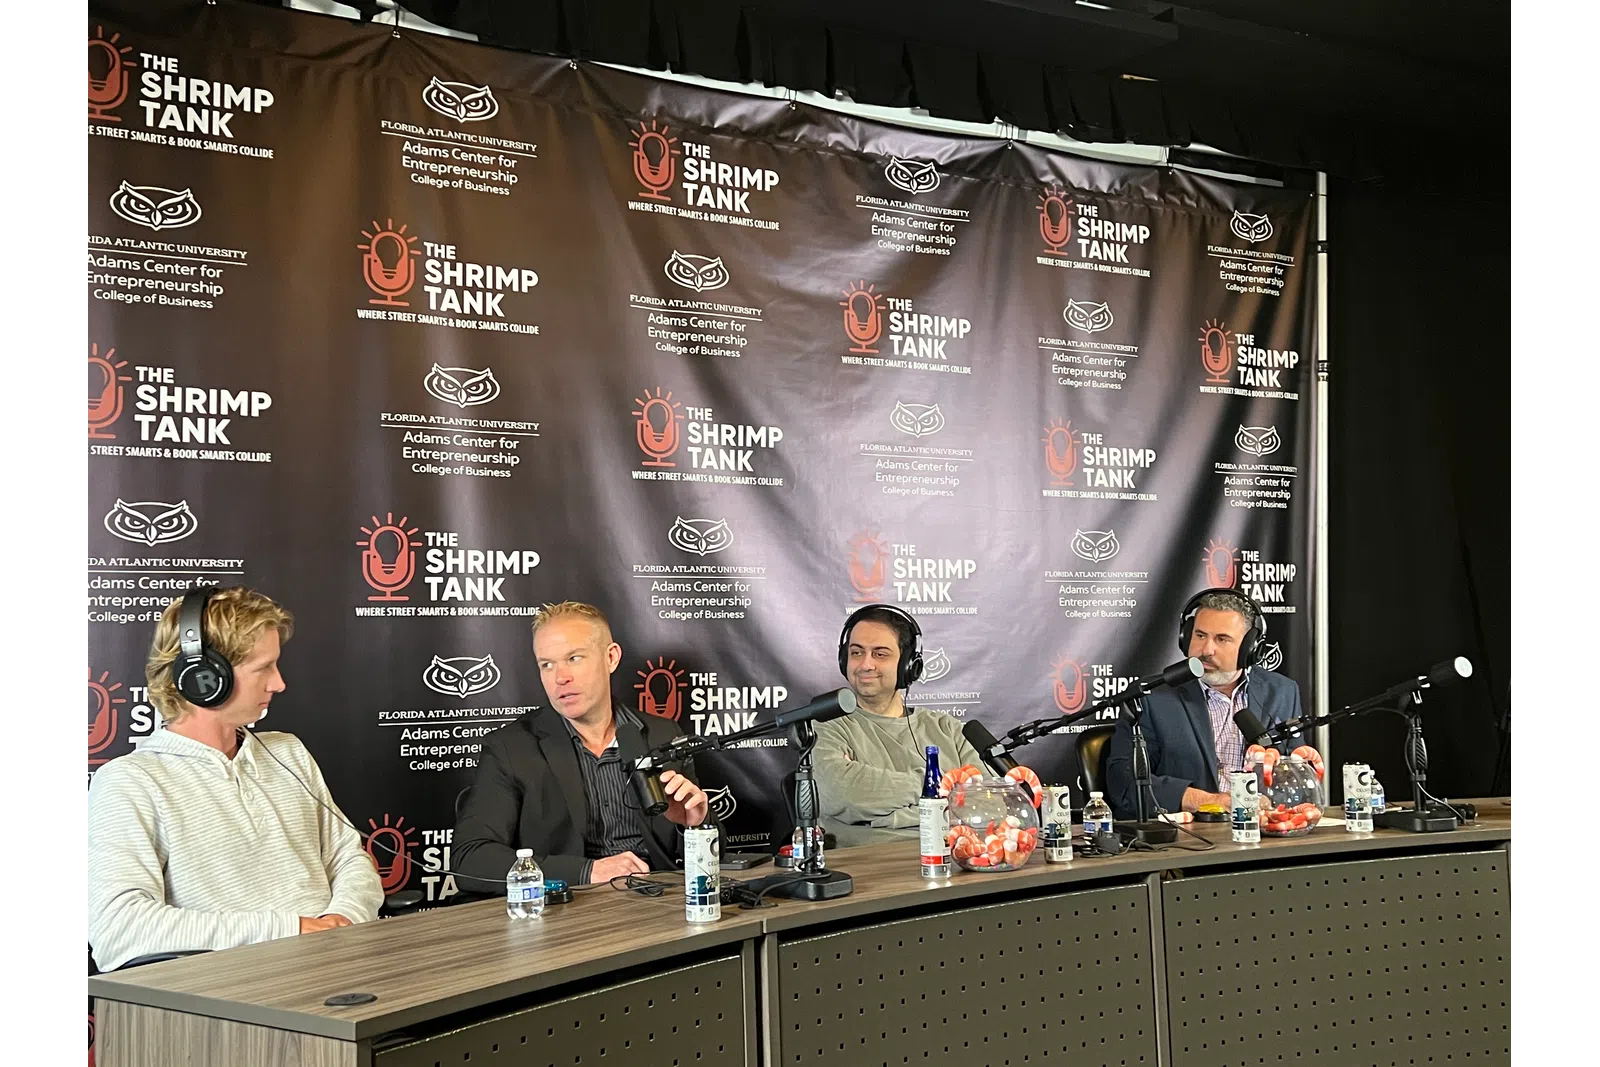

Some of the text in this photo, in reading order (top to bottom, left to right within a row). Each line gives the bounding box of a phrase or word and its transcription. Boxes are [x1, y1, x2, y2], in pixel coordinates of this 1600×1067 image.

[139, 53, 179, 73] THE
[140, 70, 276, 116] SHRIMP
[139, 100, 234, 139] TANK
[96, 126, 130, 140] STREET
[131, 130, 168, 145] SMARTS
[169, 136, 176, 147] &
[178, 137, 202, 150] BOOK
[203, 140, 238, 155] SMARTS
[239, 145, 275, 160] COLLIDE
[380, 121, 537, 152] FLORIDA ATLANTIC UNIVERSITY
[402, 140, 518, 168] Adams Center for
[682, 142, 710, 159] THE
[401, 156, 518, 186] Entrepreneurship
[683, 157, 780, 193] SHRIMP
[410, 173, 510, 196] College of Business
[683, 182, 750, 214] TANK
[629, 201, 780, 232] WHERE STREET SMARTS & BOOK SMARTS COLLIDE
[1077, 204, 1098, 217] THE
[871, 212, 954, 233] Adams Center for
[1077, 217, 1151, 245] SHRIMP
[88, 232, 248, 259] RIDA ATLANTIC UNIVERSITY
[871, 225, 955, 248] Entrepreneurship
[423, 242, 456, 259] THE
[1077, 238, 1129, 263] TANK
[88, 253, 224, 278] Adams Center for
[88, 270, 224, 297] Entrepreneurship
[423, 259, 540, 294] SHRIMP
[93, 289, 214, 309] College of Business
[423, 286, 504, 317] TANK
[888, 297, 912, 311] THE
[357, 308, 540, 336] WHERE STREET SMARTS & BOOK SMARTS COLLIDE
[646, 312, 747, 332] Adams Center for
[888, 311, 972, 340] SHRIMP
[646, 327, 748, 348] Entrepreneurship
[889, 334, 947, 360] TANK
[1236, 334, 1254, 345] THE
[654, 342, 741, 358] College of Business
[1052, 352, 1126, 367] Adams Center for
[1236, 346, 1299, 369] SHRIMP
[135, 366, 175, 384] THE
[1052, 364, 1127, 381] Entrepreneurship
[1235, 366, 1279, 388] TANK
[1058, 377, 1121, 390] College of Business
[135, 384, 274, 418] SHRIMP
[381, 413, 539, 431] FLORIDA ATLANTIC UNIVERSITY
[685, 406, 713, 421] THE
[134, 414, 231, 445] TANK
[686, 422, 784, 449] SHRIMP
[1081, 433, 1103, 445] THE
[403, 431, 519, 449] Adams Center for
[403, 447, 519, 467] Entrepreneurship
[686, 447, 754, 472] TANK
[875, 459, 909, 470] Adams
[911, 461, 942, 472] Center
[1082, 446, 1158, 468] SHRIMP
[412, 463, 511, 477] College of Business
[1083, 468, 1135, 489] TANK
[1223, 476, 1292, 486] Adams Center for
[1224, 488, 1293, 499] Entrepreneurship
[425, 532, 458, 547] THE
[891, 544, 916, 556] THE
[1241, 551, 1260, 561] THE
[425, 549, 541, 574] SHRIMP
[892, 558, 978, 579] SHRIMP
[1242, 563, 1296, 581] SHRIMP
[425, 577, 505, 601] TANK
[651, 581, 751, 592] Adams Center for
[892, 581, 953, 602] TANK
[1058, 584, 1089, 594] Adams
[1091, 585, 1120, 594] Center
[1241, 584, 1284, 602] TANK
[356, 607, 386, 616] WHERE
[387, 607, 416, 616] STREET
[417, 607, 449, 616] SMARTS
[450, 607, 457, 616] &
[458, 607, 479, 616] BOOK
[480, 607, 509, 616] SMARTS
[650, 595, 752, 608] Entrepreneurship
[658, 610, 692, 620] College
[694, 610, 703, 618] of
[689, 672, 717, 687] THE
[1092, 664, 1113, 676] THE
[689, 685, 789, 711] SHRIMP
[378, 710, 424, 719] FLORIDA
[427, 708, 479, 718] ATLANTIC
[400, 728, 450, 740] Adams
[689, 712, 758, 737] TANK
[762, 737, 789, 747] COLLIDE
[409, 758, 464, 772] College of
[422, 829, 454, 845] THE
[421, 875, 460, 901] TA
